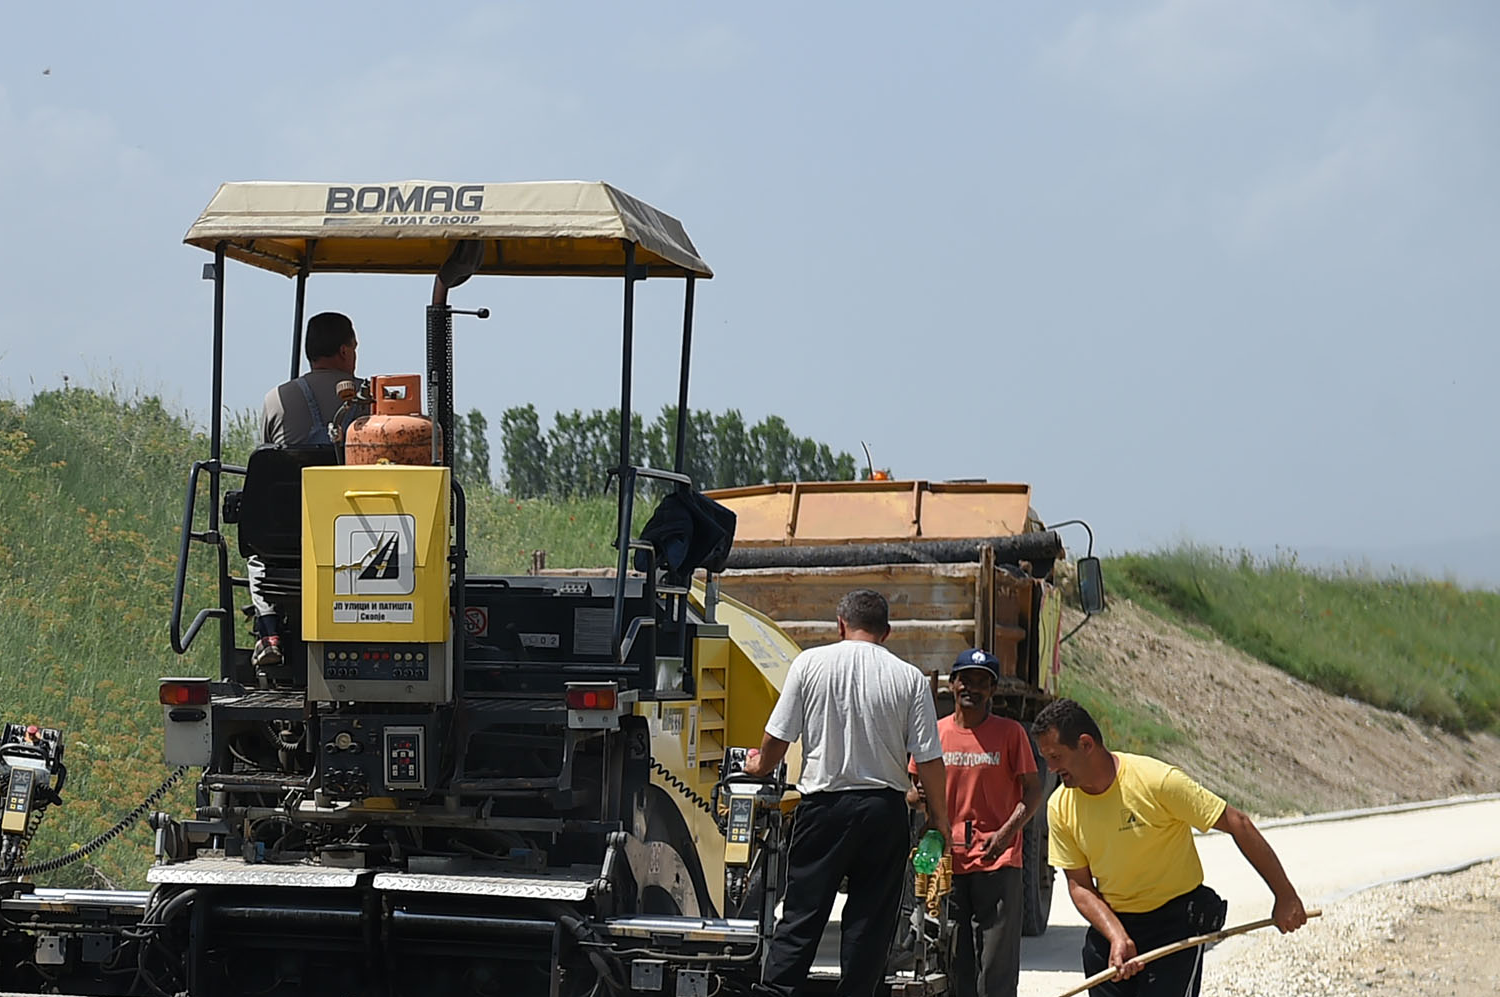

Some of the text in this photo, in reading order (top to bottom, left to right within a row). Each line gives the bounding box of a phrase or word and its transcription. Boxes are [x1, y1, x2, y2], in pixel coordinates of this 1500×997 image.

[326, 186, 484, 213] BOMAG
[381, 216, 480, 225] FAYAT GROUP
[345, 602, 370, 611] УЛИЦИ
[371, 602, 377, 610] И
[379, 602, 412, 610] ПАТИШТА
[361, 612, 385, 621] Скопје
